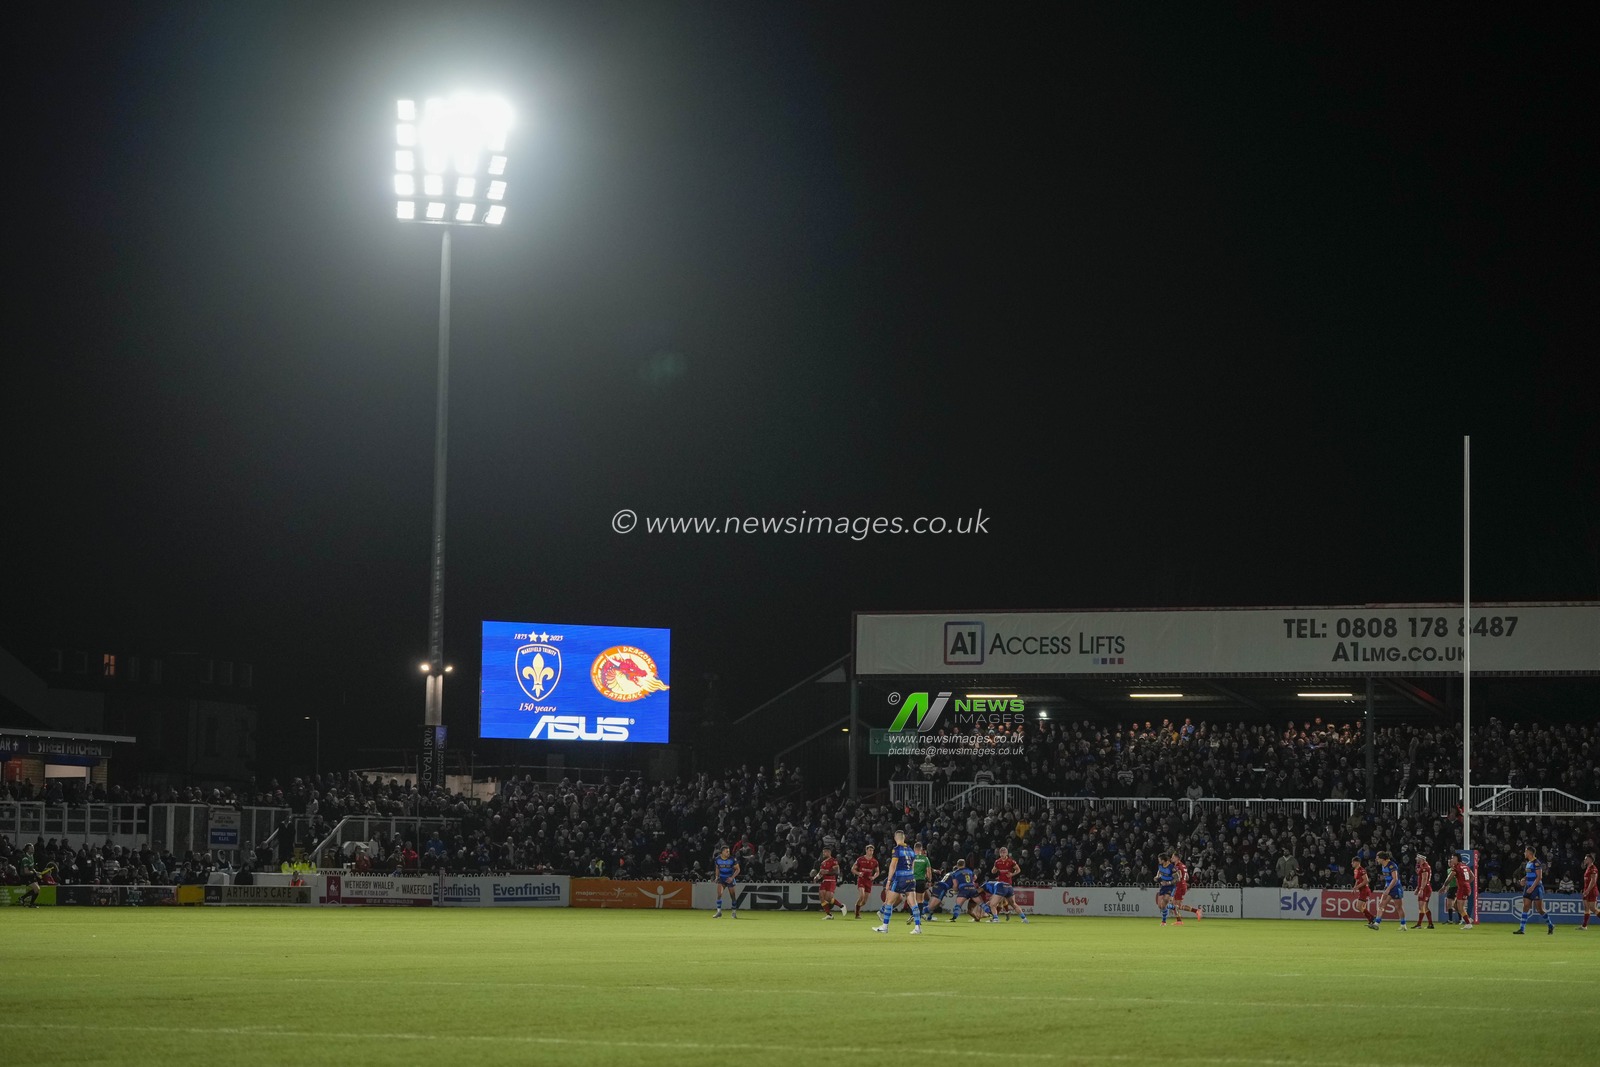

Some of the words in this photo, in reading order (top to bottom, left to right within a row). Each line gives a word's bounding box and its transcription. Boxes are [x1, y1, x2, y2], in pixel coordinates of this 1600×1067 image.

[1284, 618, 1327, 638] TEL:
[1336, 617, 1398, 638] 0808
[1408, 617, 1448, 638] 178
[1457, 617, 1519, 638] 8487
[950, 632, 976, 655] A1
[989, 632, 1071, 655] ACCESS
[622, 646, 655, 669] DRAGONS
[603, 690, 642, 700] CATALANS
[519, 702, 534, 711] 150
[534, 705, 557, 713] years
[37, 742, 65, 753] STREET
[67, 743, 102, 755] KITCHEN
[227, 887, 268, 898] ARTHUR'S
[344, 880, 372, 890] WETHERBY
[373, 881, 395, 890] WHALER
[402, 884, 433, 895] WAKEFIELD
[433, 883, 480, 896] Eenfinish
[493, 883, 560, 896] Evenfinish
[1062, 891, 1089, 906] Casa
[1280, 892, 1318, 916] sky
[1104, 903, 1139, 912] ESTÁBULO
[1536, 901, 1576, 913] UPER
